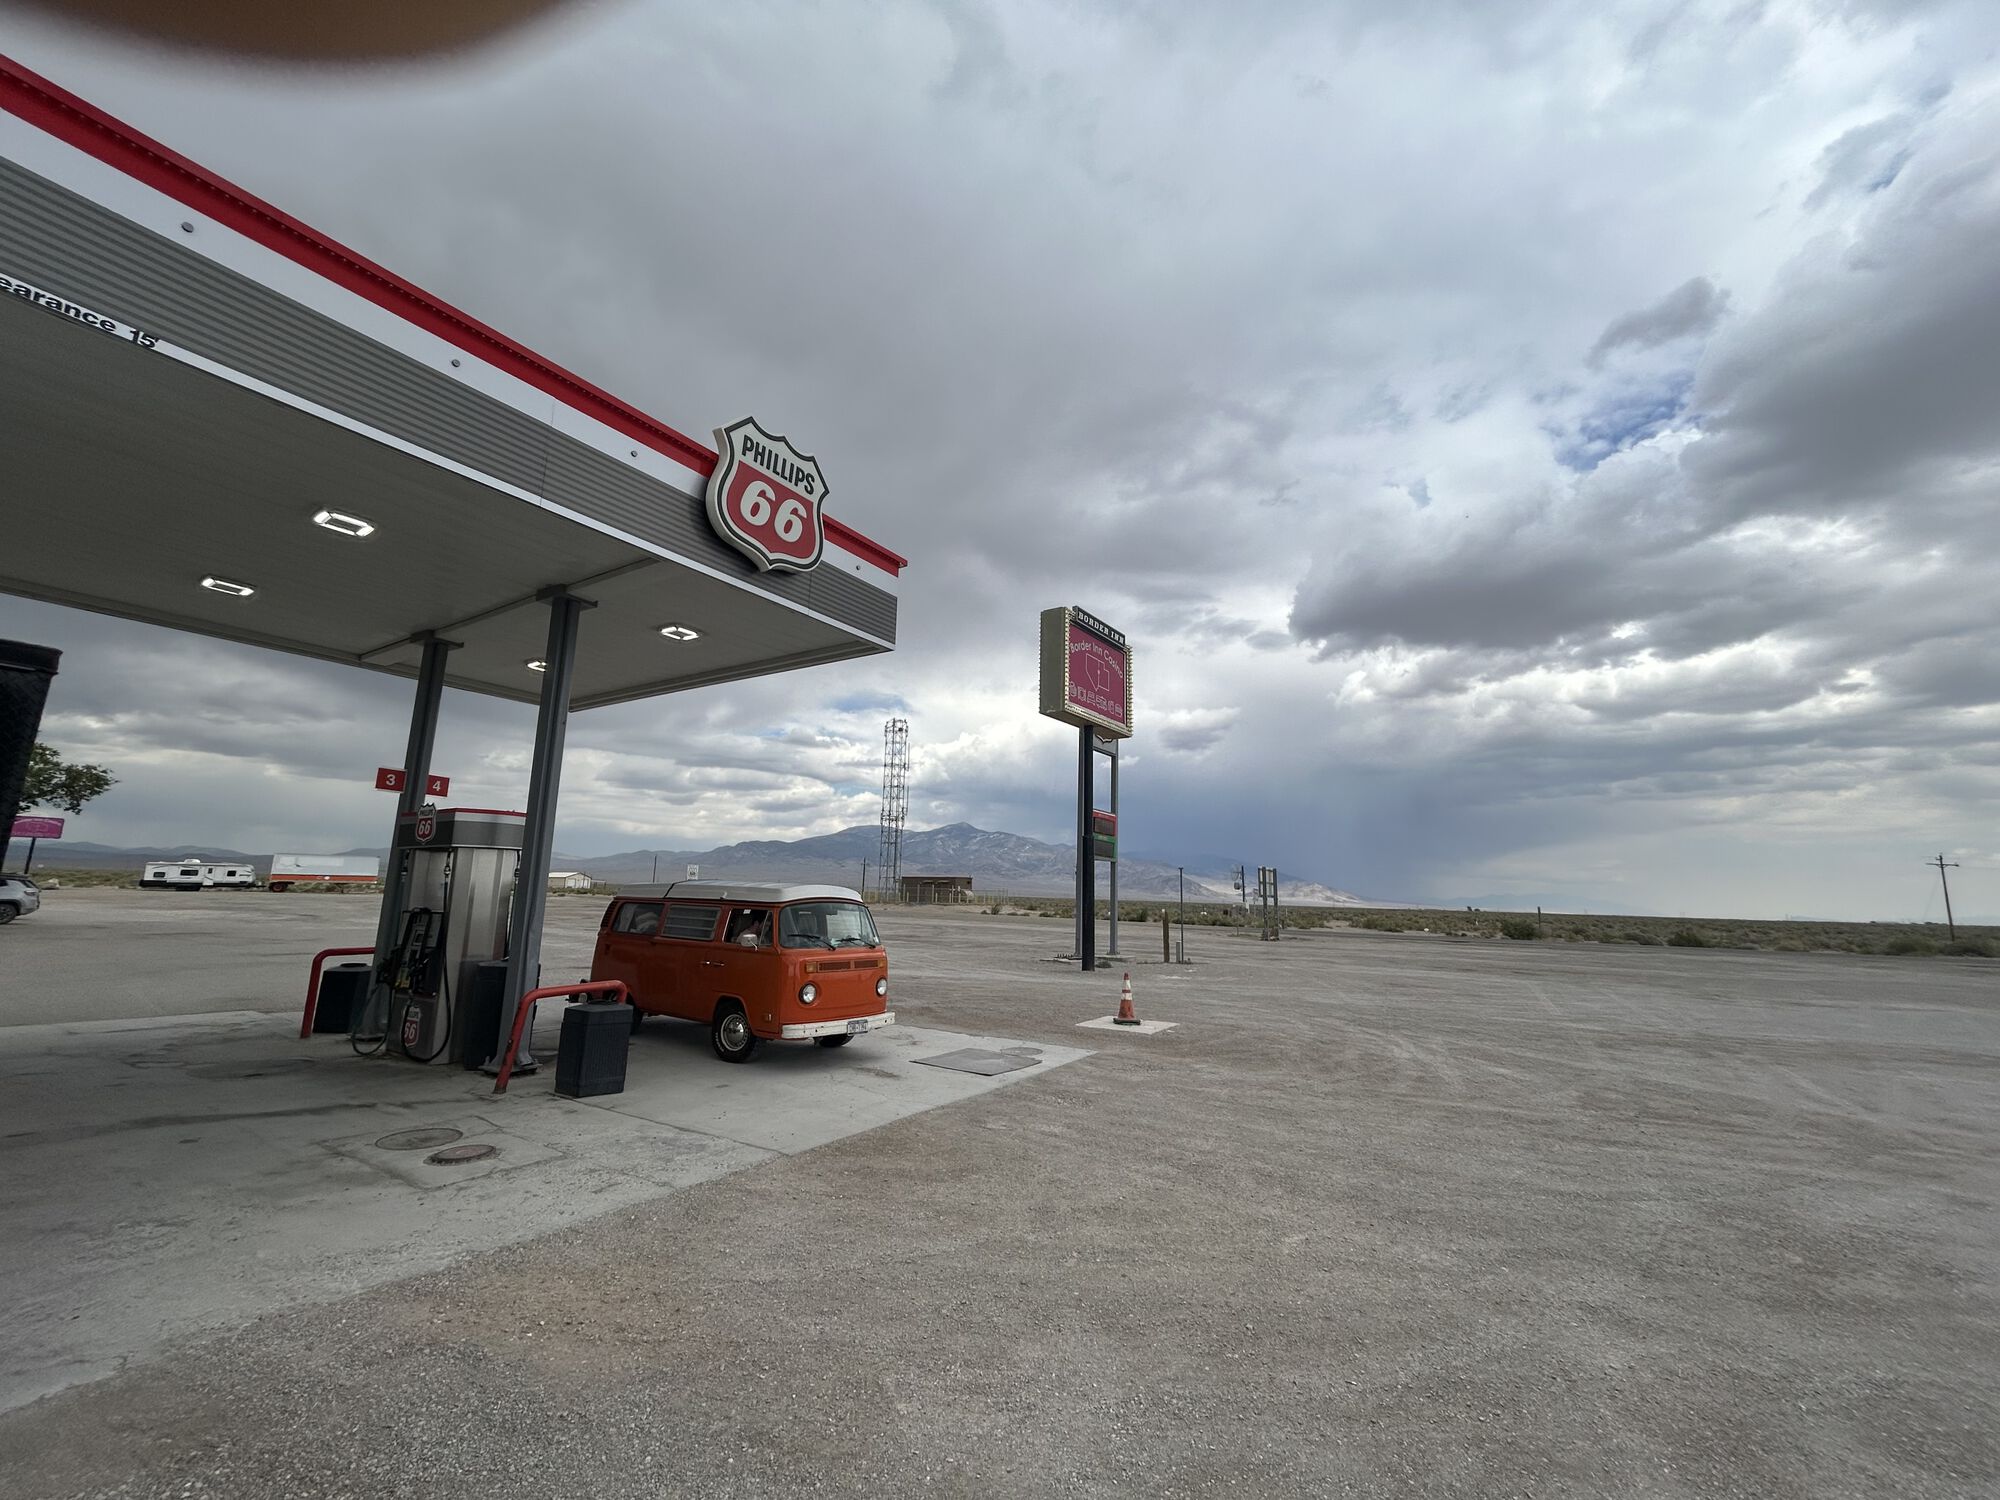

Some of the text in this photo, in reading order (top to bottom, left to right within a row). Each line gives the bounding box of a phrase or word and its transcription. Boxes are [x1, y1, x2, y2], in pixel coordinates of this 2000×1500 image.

[742, 435, 815, 495] PHILLIPS
[740, 480, 807, 542] 66
[1078, 611, 1124, 644] BORDER INN
[1069, 641, 1124, 679] Border Inn Casino
[386, 774, 396, 786] 3
[433, 781, 441, 791] 4
[419, 821, 431, 835] 66
